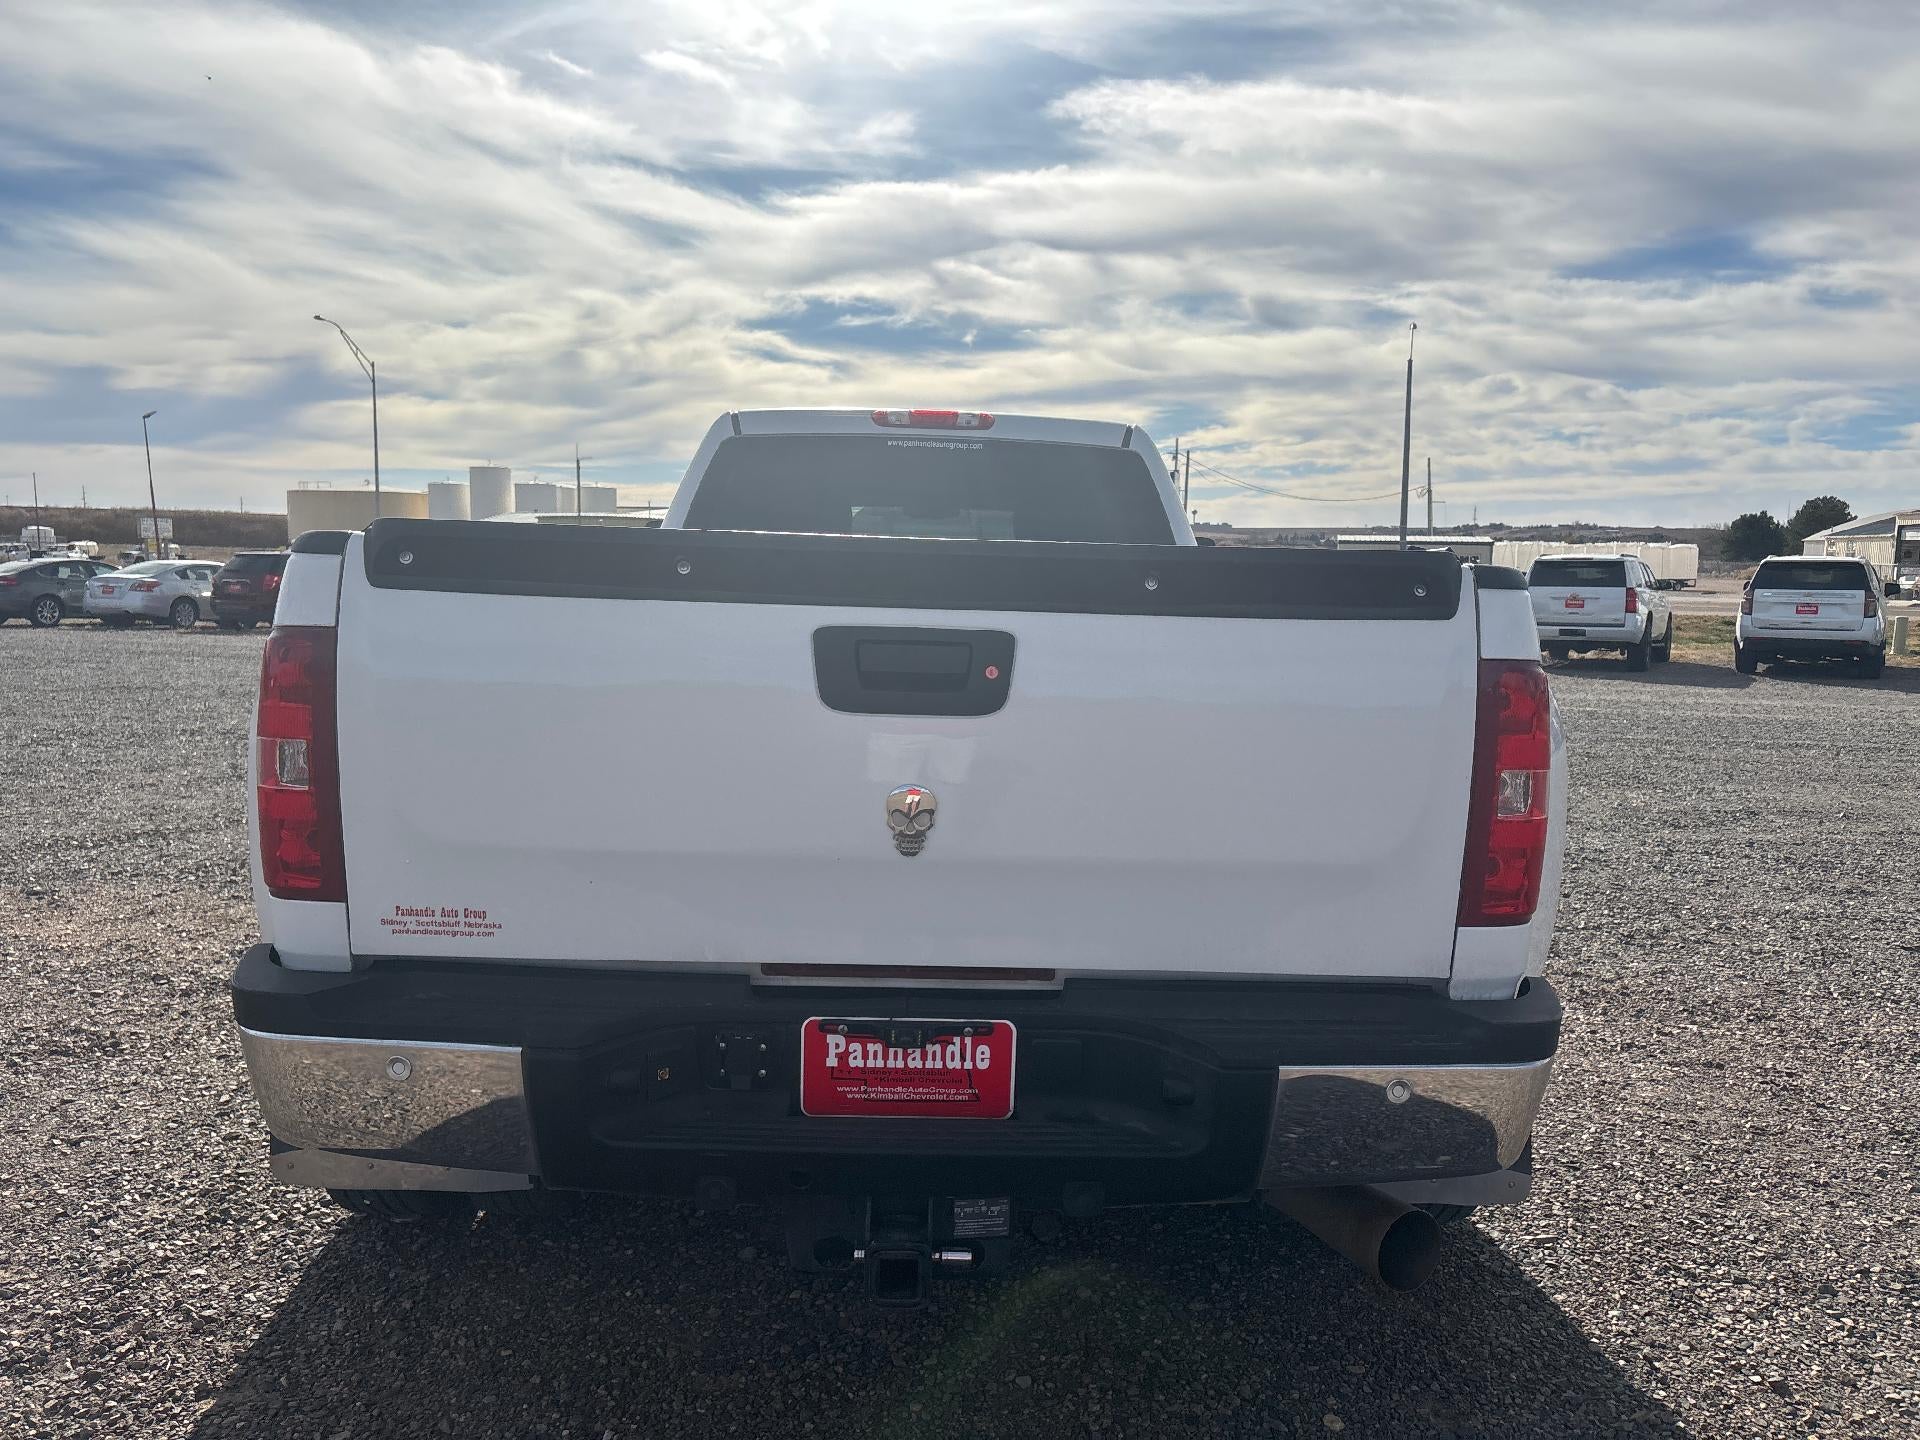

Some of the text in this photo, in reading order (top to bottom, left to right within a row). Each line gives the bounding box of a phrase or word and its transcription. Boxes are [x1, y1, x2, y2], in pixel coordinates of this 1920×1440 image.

[887, 440, 983, 450] www.panhandleautogroup.com
[395, 905, 487, 921] Panhandle Auto Group
[380, 919, 502, 929] Sidney Scottsbluff Nebraska
[392, 928, 495, 938] panhandleautogroup.com
[826, 1034, 991, 1070] Panhandle
[860, 1069, 891, 1077] Sidney
[879, 1076, 914, 1084] Kimball
[837, 1085, 978, 1095] www.PanhandleAutoGroup.com
[846, 1092, 969, 1101] www.KimballChevrolet.com
